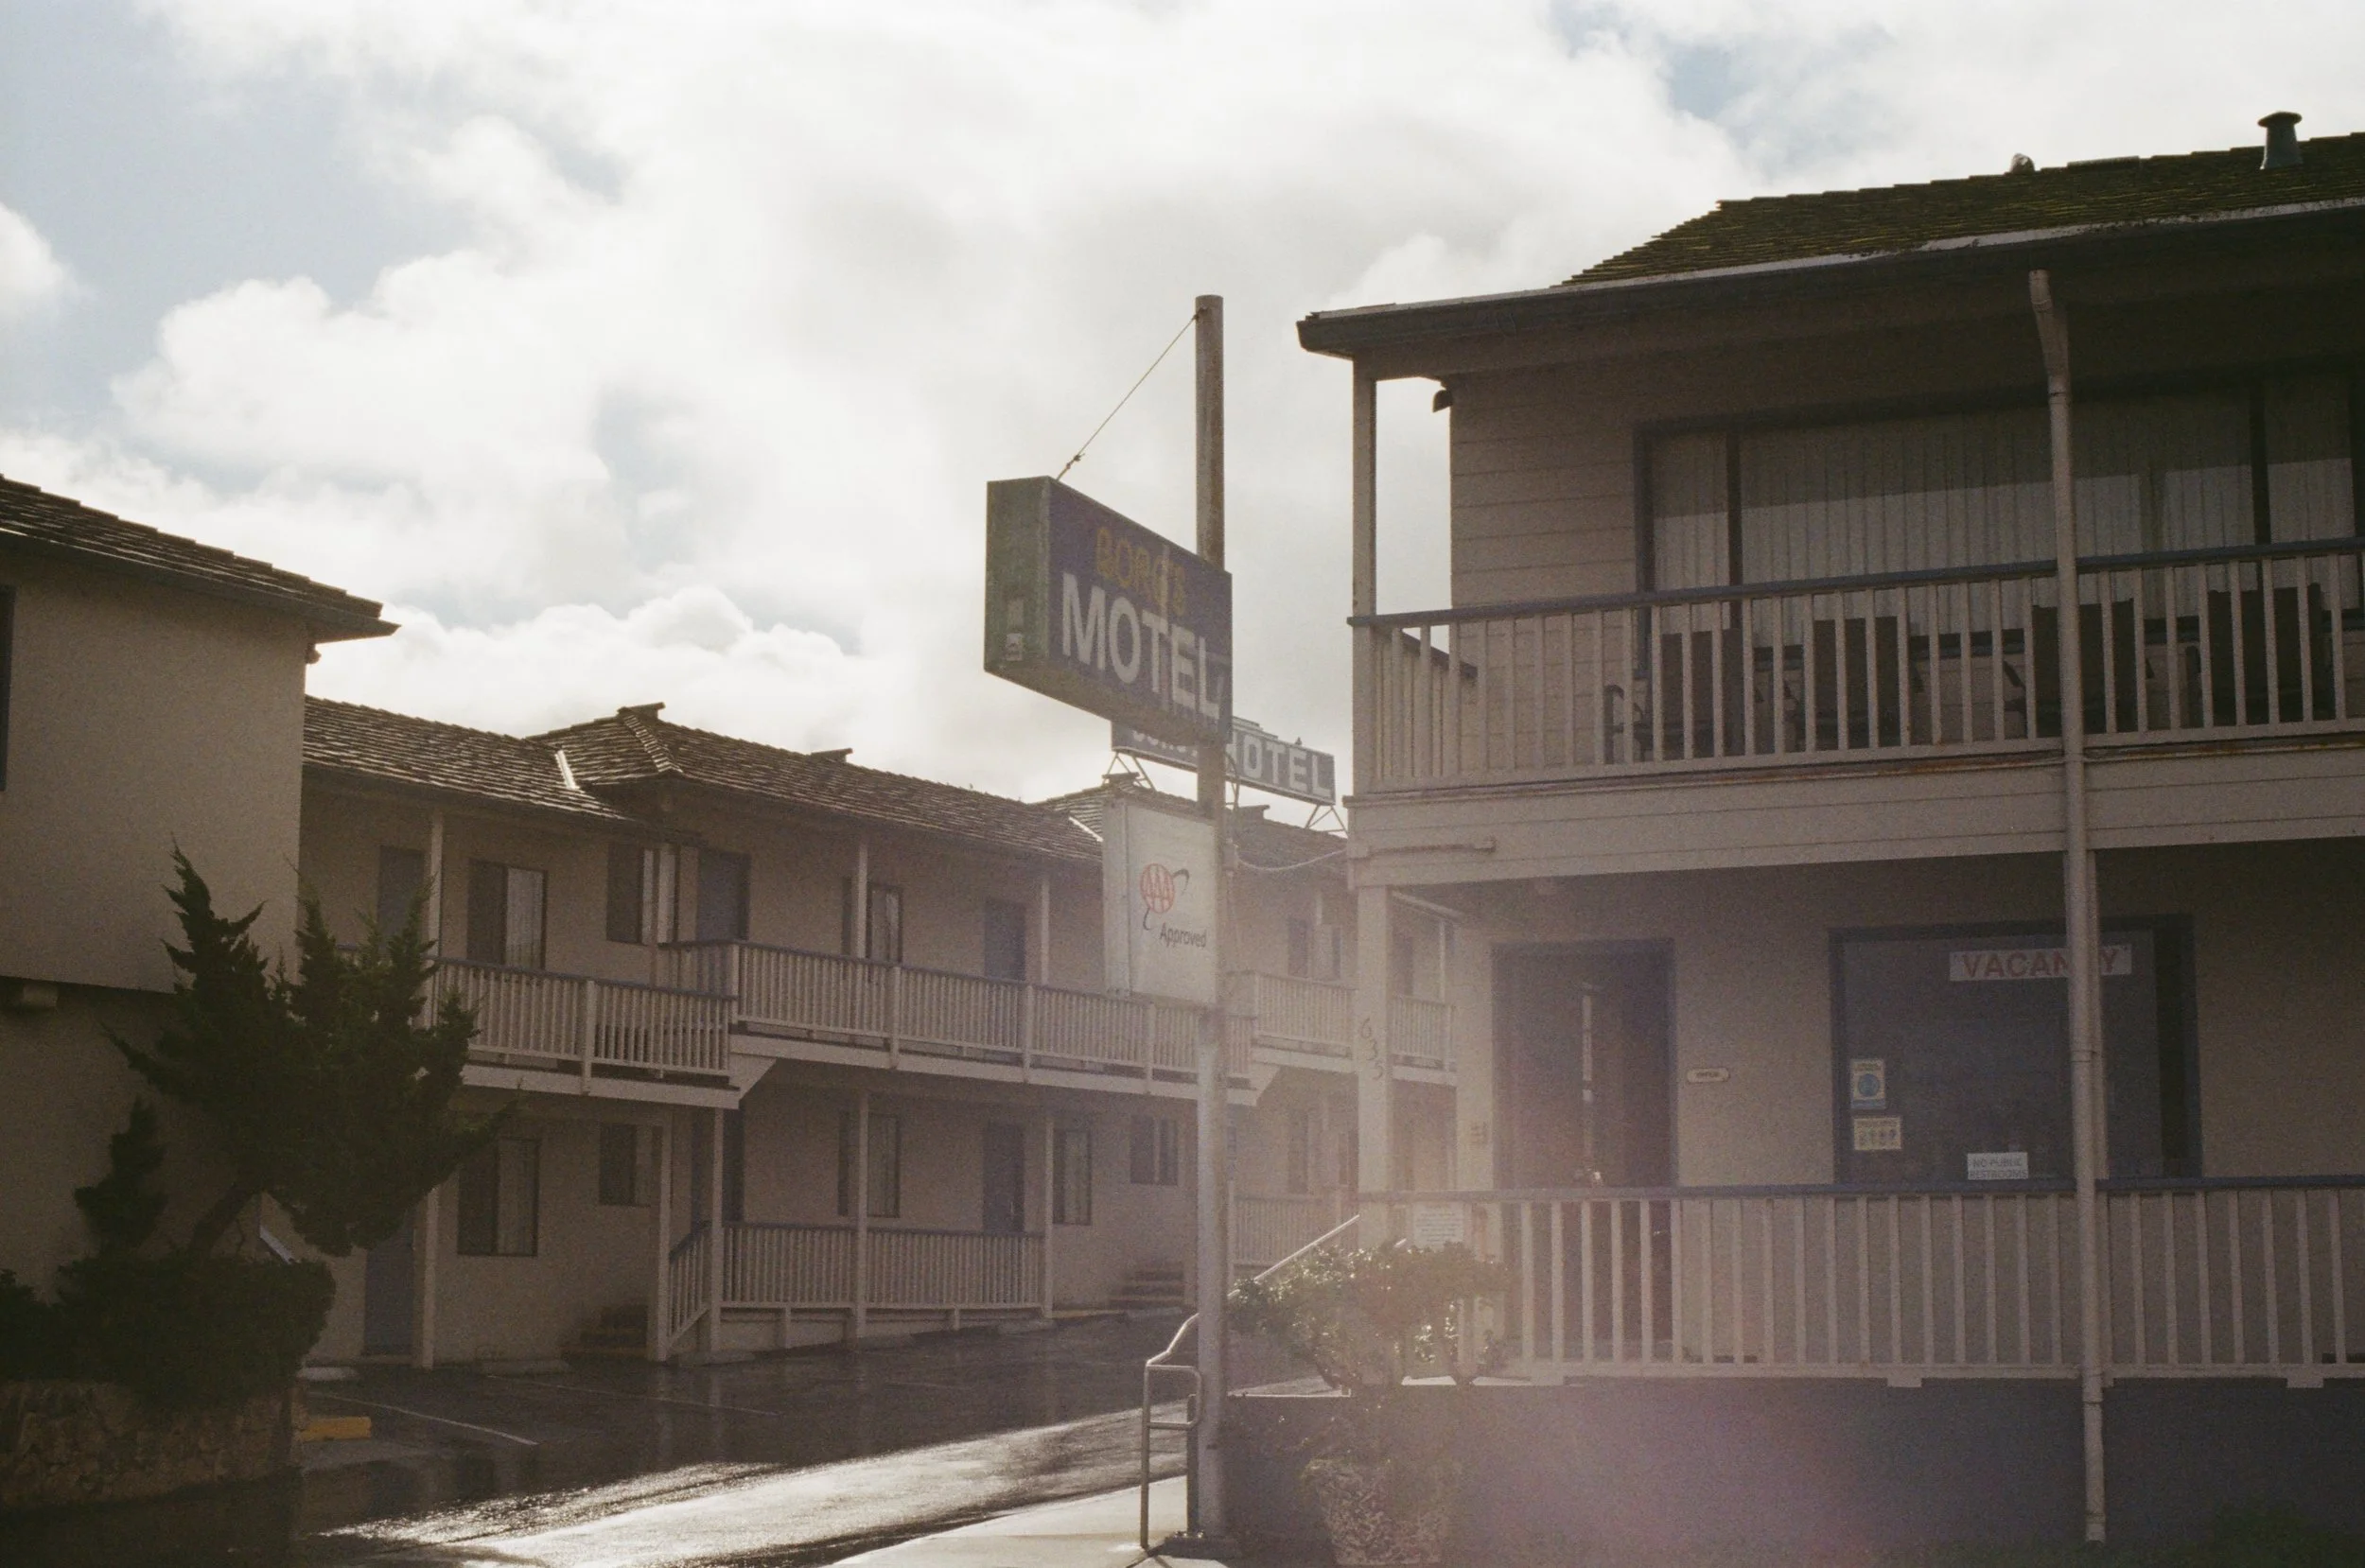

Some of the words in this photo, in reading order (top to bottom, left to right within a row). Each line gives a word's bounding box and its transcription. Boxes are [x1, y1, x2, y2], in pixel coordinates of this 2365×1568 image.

[1062, 572, 1219, 719] MOTEL
[1159, 921, 1207, 948] Approved
[1961, 949, 2119, 978] VACANY
